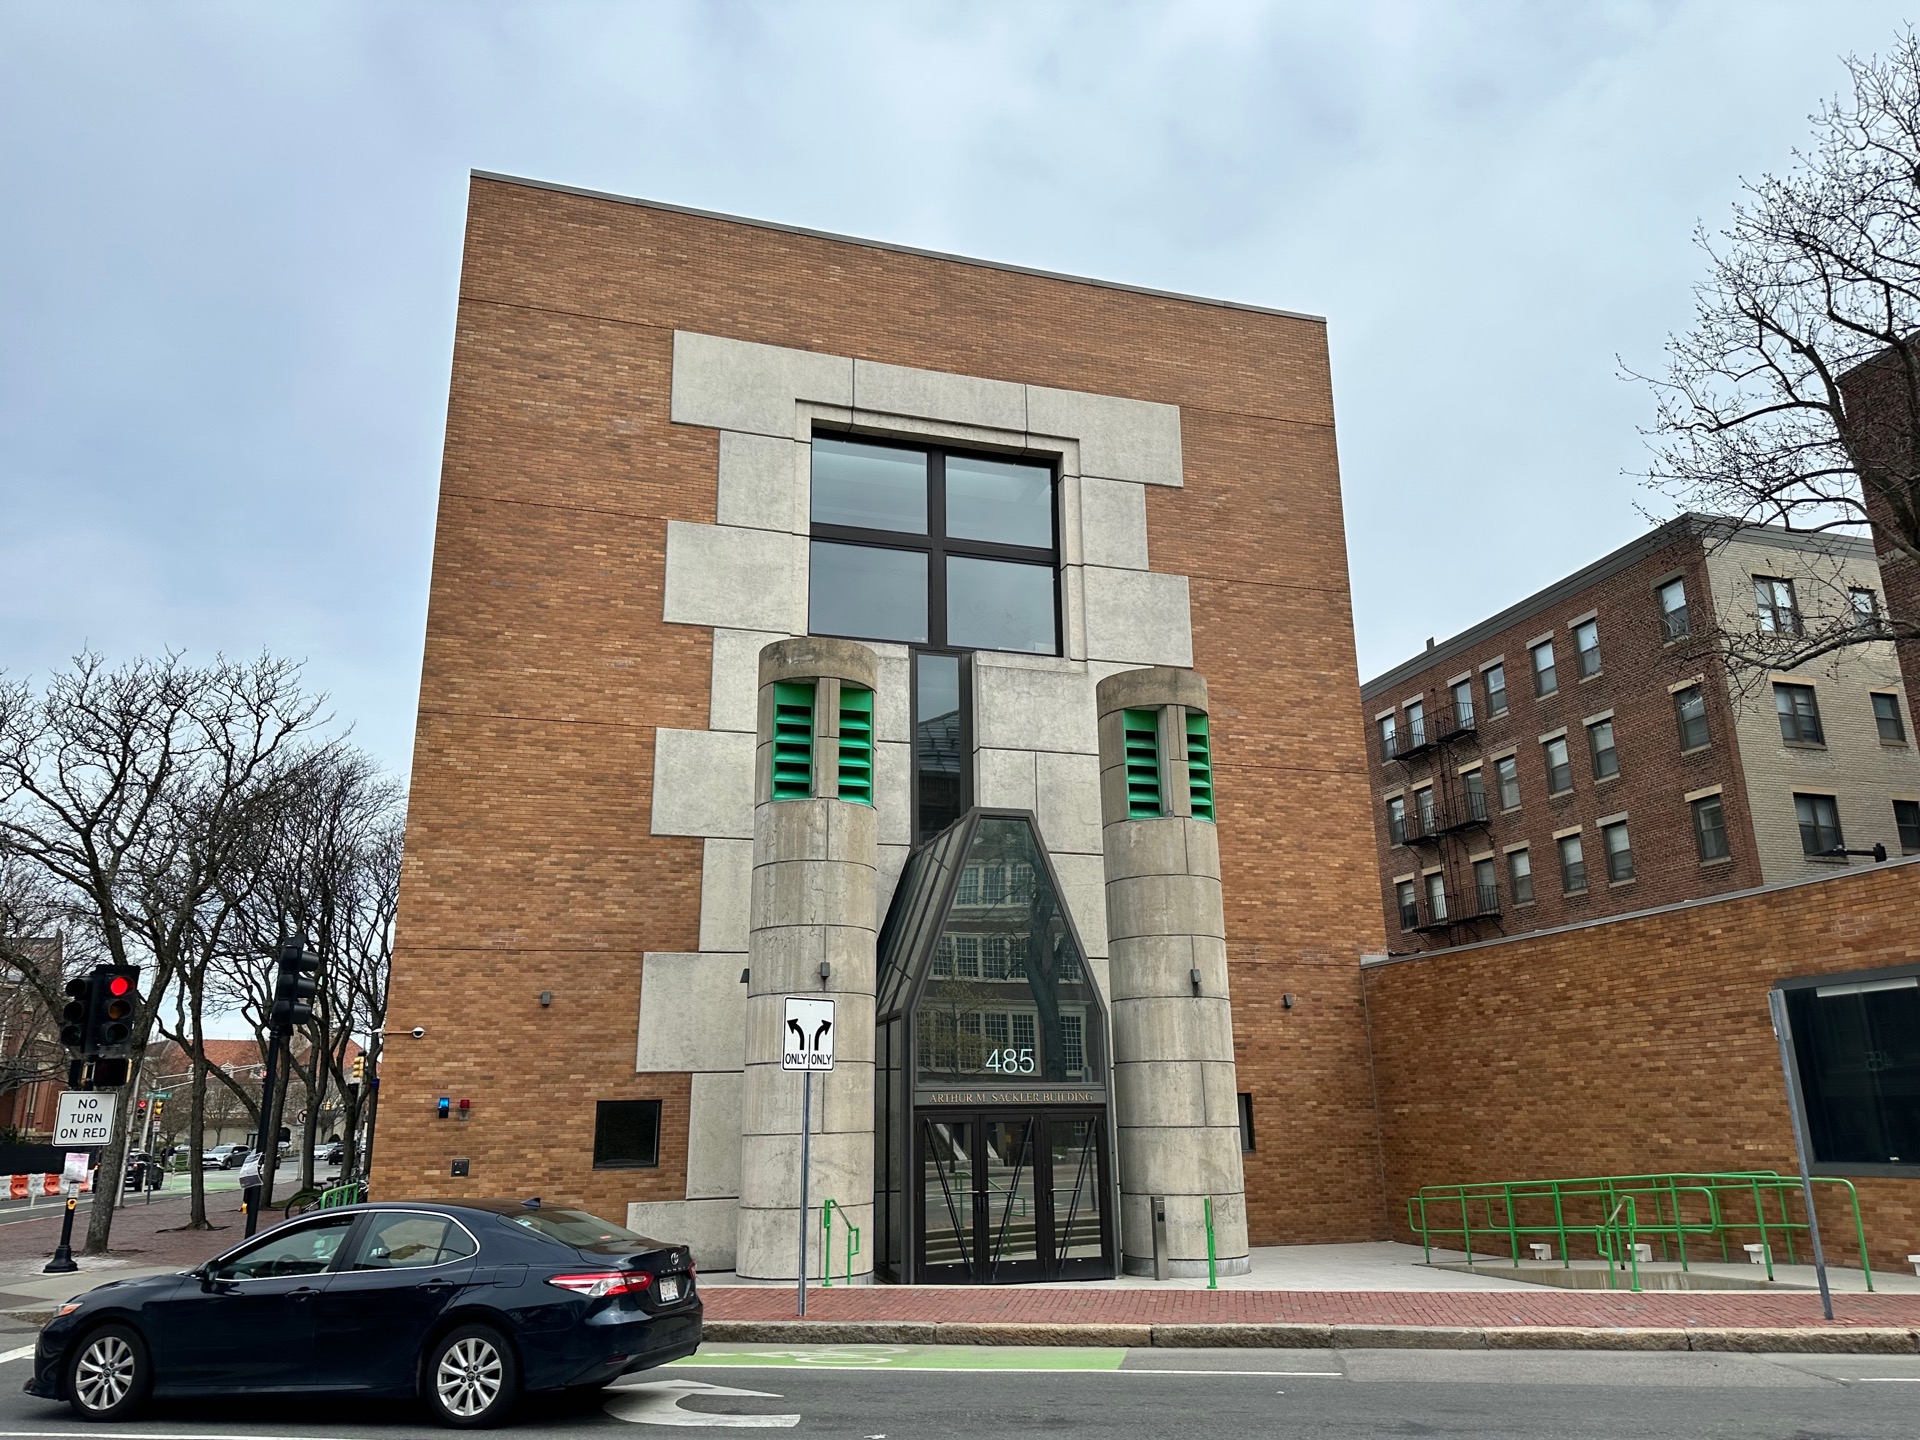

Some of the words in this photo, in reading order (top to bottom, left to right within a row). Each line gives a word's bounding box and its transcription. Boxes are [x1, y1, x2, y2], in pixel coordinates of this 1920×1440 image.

[785, 1053, 807, 1065] ONLY
[811, 1053, 832, 1065] ONLY
[985, 1048, 1035, 1073] 485
[930, 1093, 973, 1103] ARTHUR
[991, 1092, 1039, 1102] SACKLER
[1043, 1092, 1093, 1102] BUILDING
[78, 1098, 98, 1109] NO
[70, 1113, 103, 1124] TURN
[60, 1128, 78, 1139] ON
[83, 1127, 107, 1138] RED
